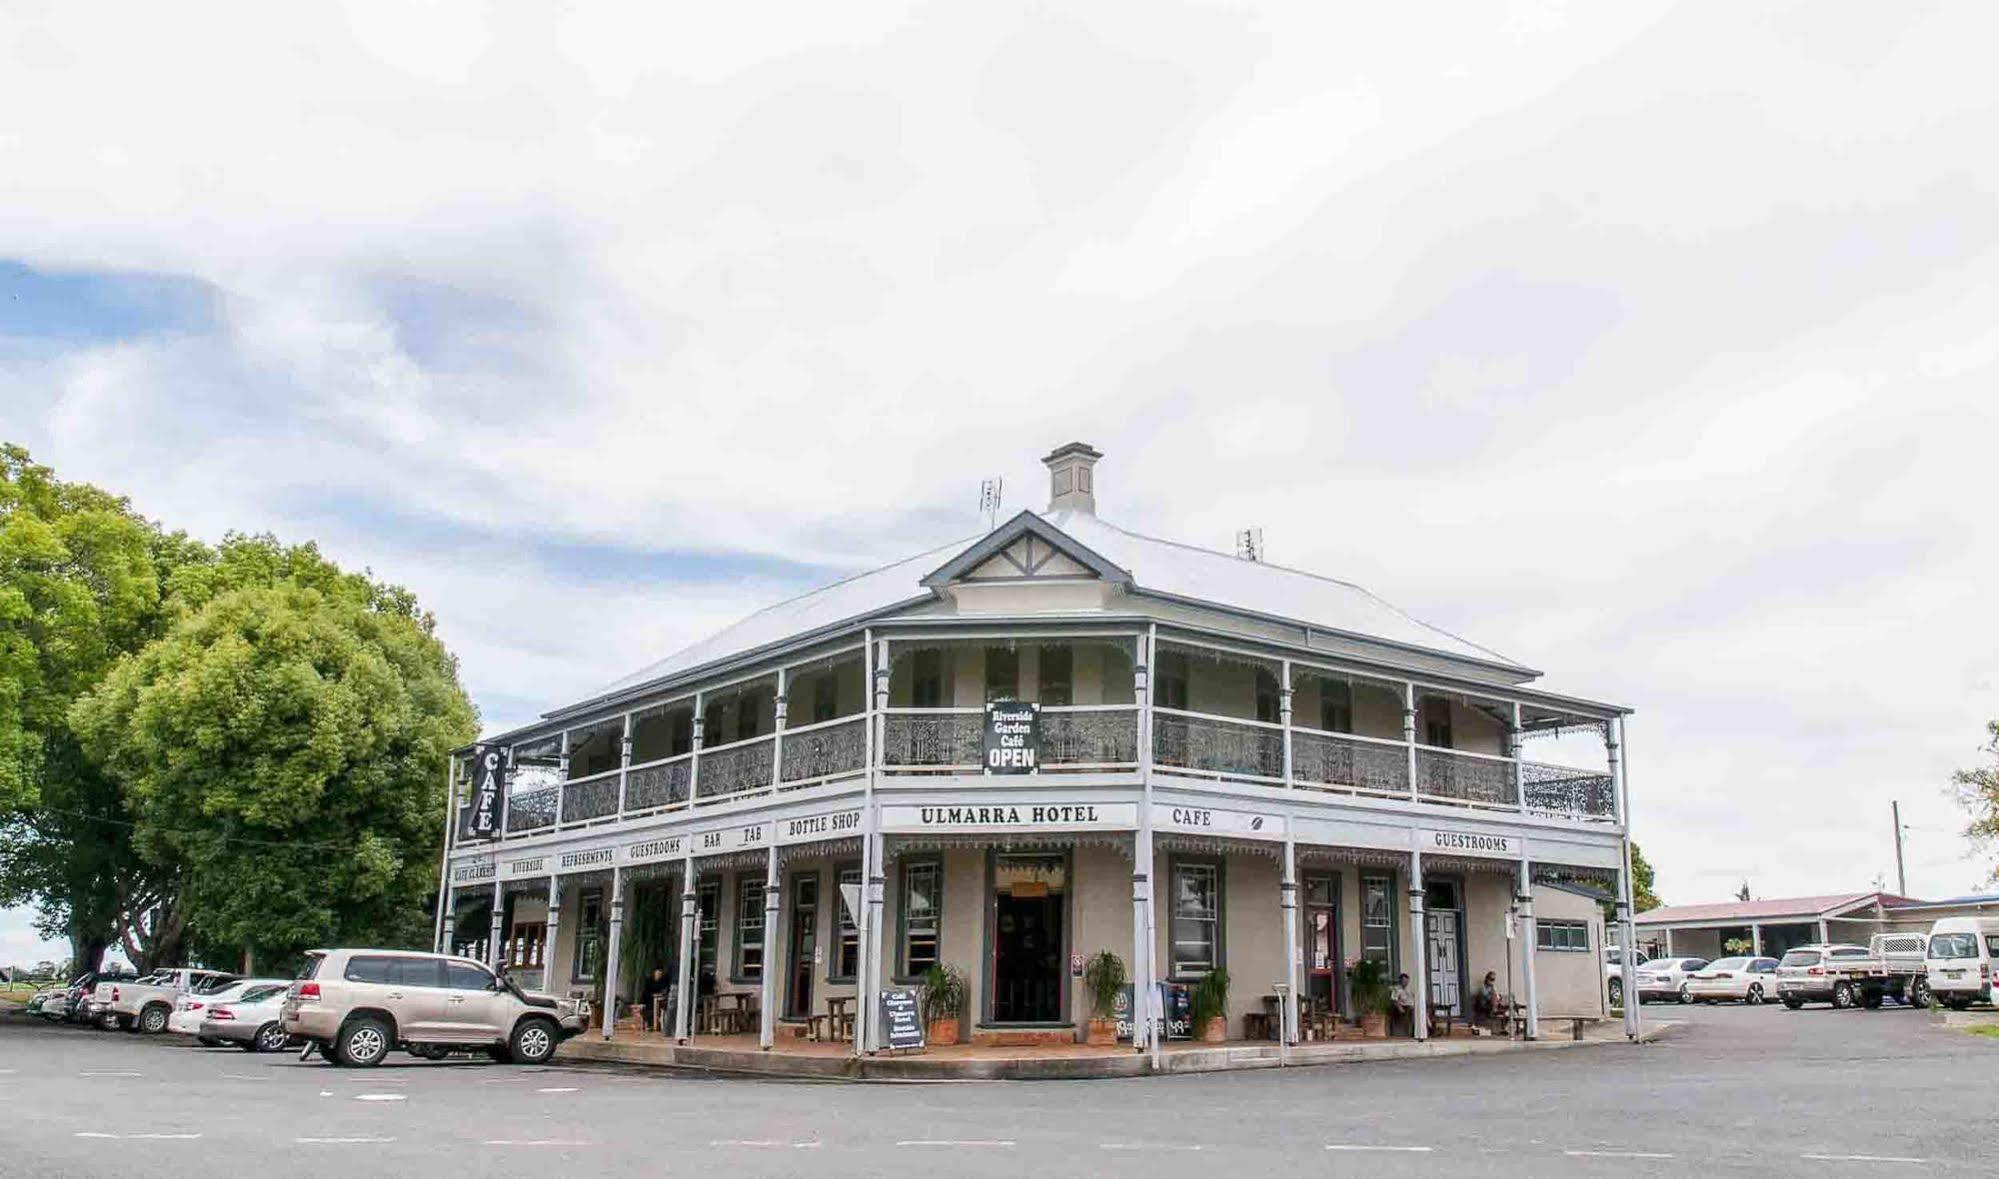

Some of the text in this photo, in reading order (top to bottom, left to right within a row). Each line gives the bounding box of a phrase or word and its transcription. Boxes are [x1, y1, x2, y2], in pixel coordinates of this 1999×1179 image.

[992, 710, 1033, 721] Riverside
[994, 722, 1030, 734] Garden
[1000, 734, 1024, 747] Café
[989, 748, 1035, 767] OPEN
[478, 753, 499, 830] CAFE
[921, 806, 1098, 823] ULMARRA HOTEL
[1173, 808, 1211, 826] CAFE
[789, 812, 860, 836] BOTTLE SHOP
[704, 826, 762, 848] BAR TAB
[1435, 832, 1507, 851] GUESTROOMS
[630, 838, 681, 859] GUESTROOMS
[512, 859, 545, 874] RIVERSIDE
[561, 849, 613, 867] REFRESHMENTS
